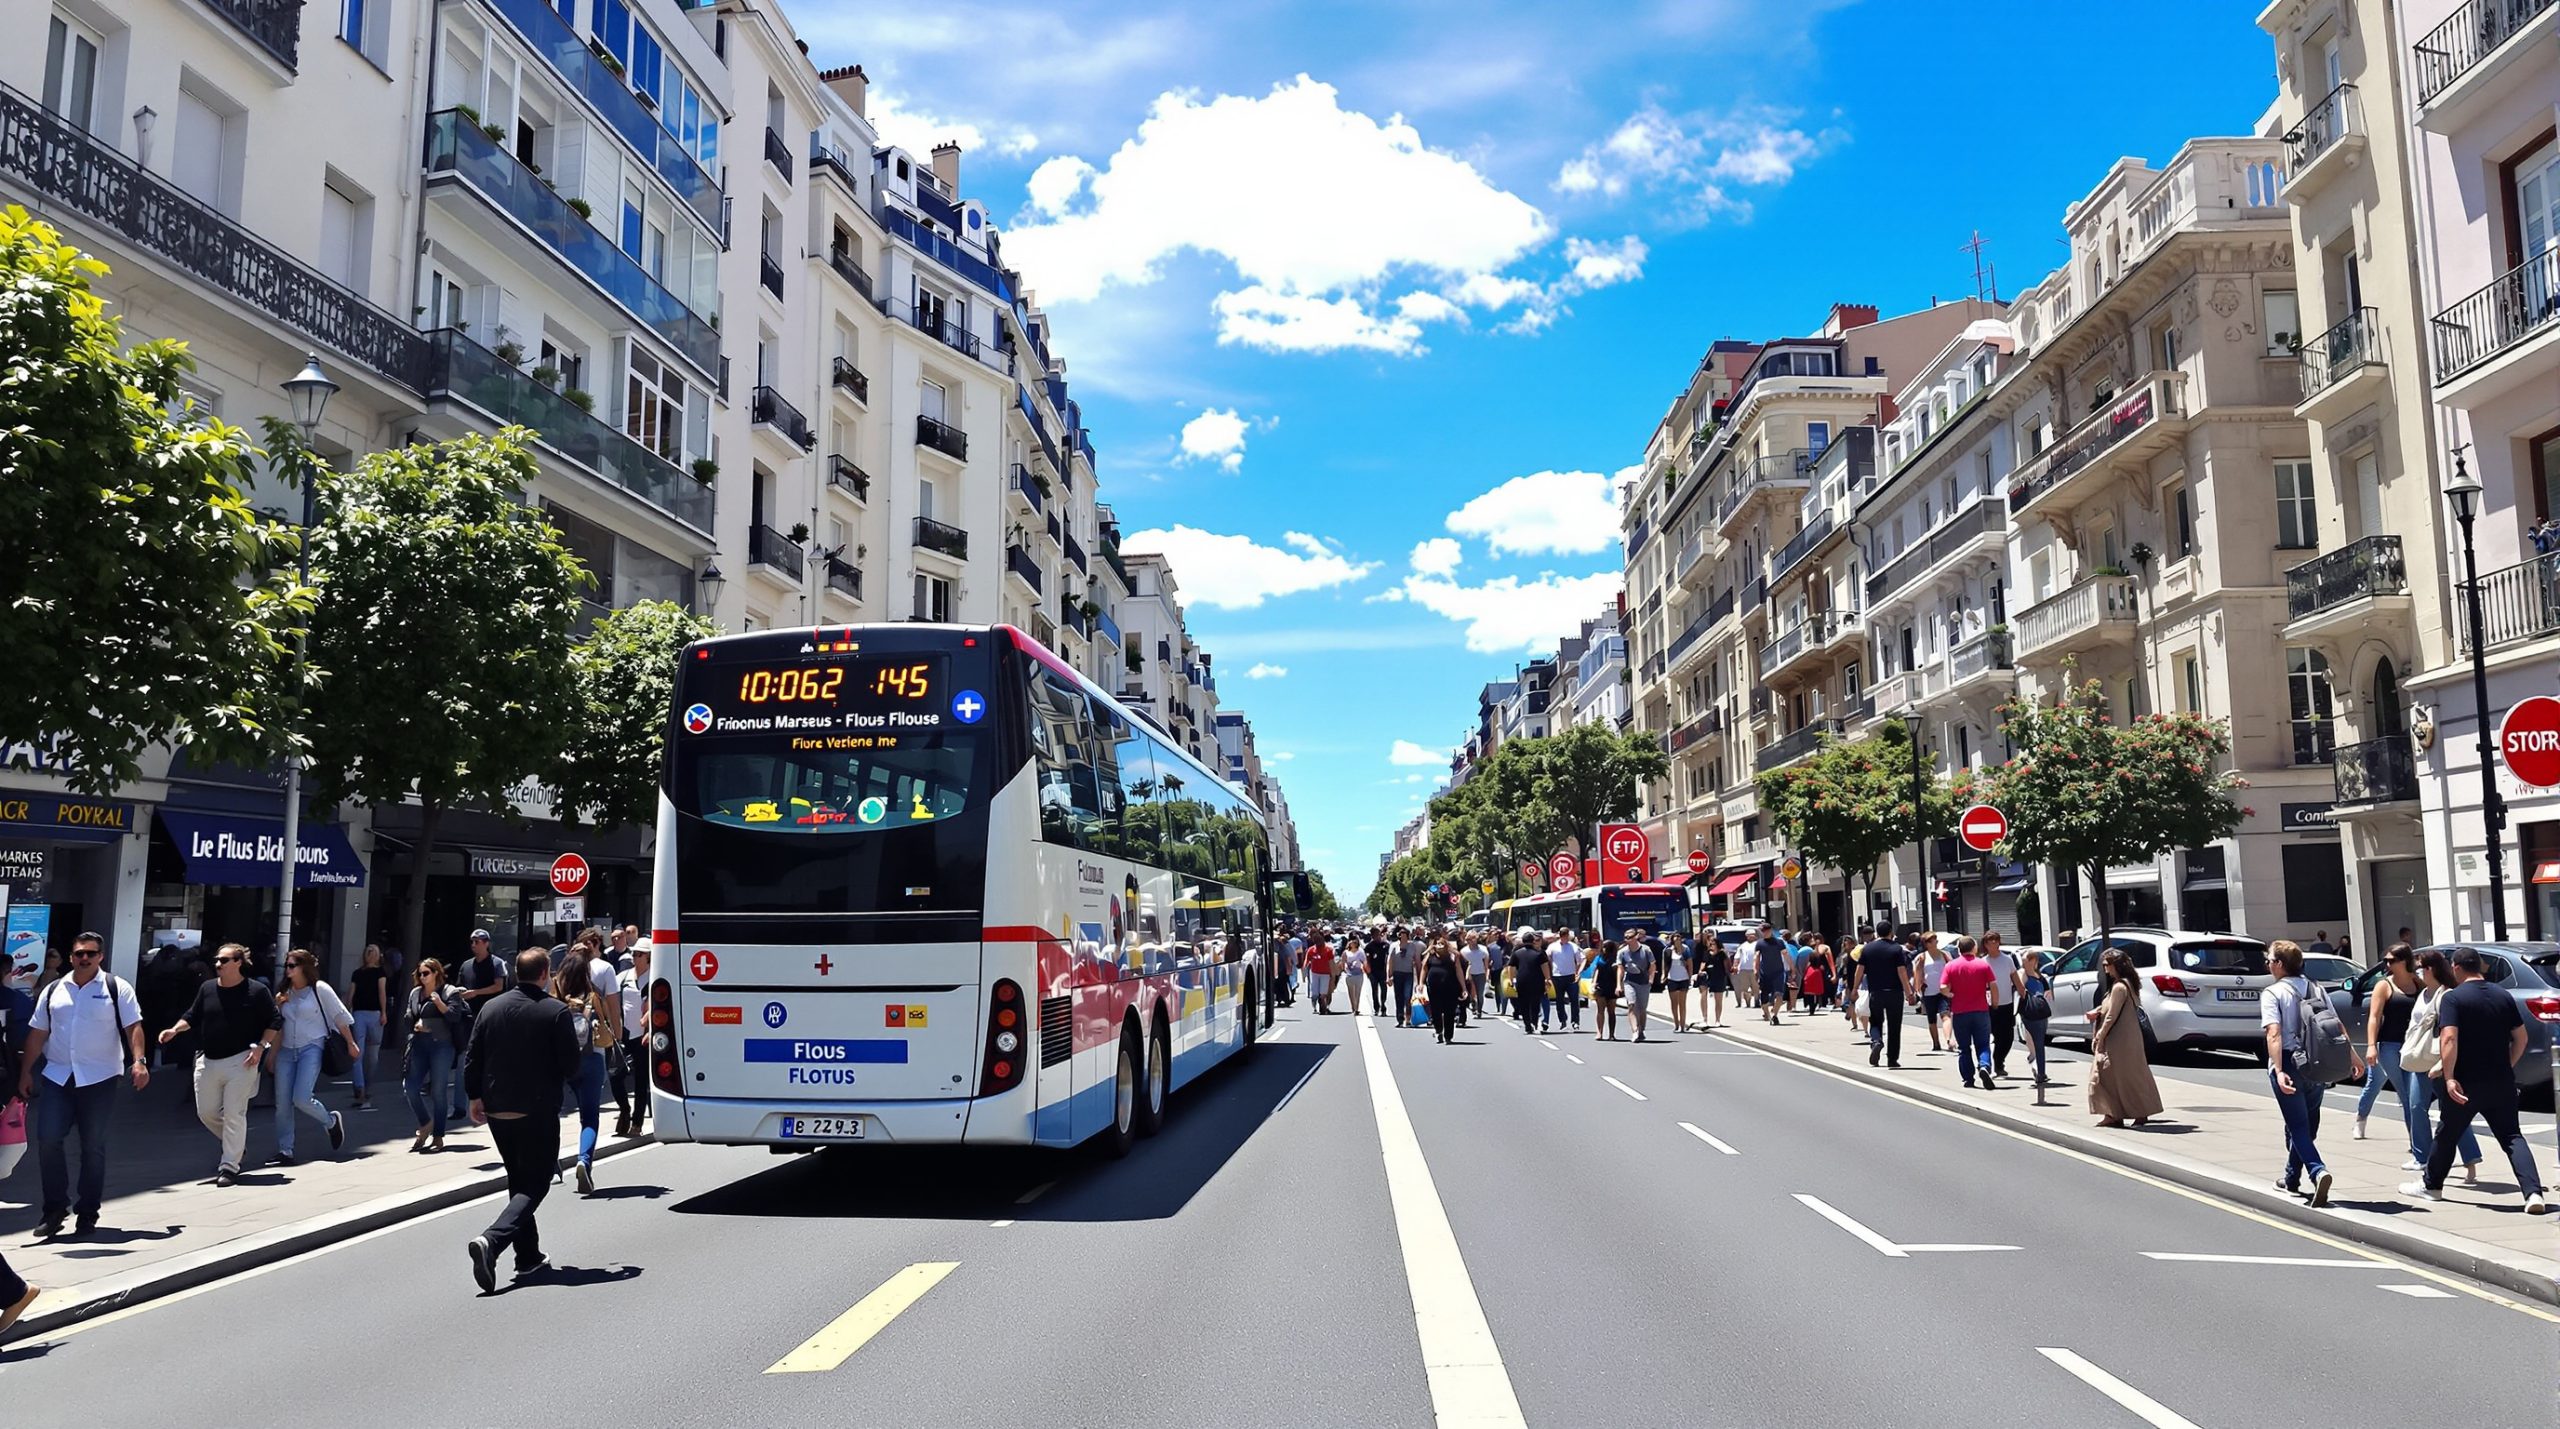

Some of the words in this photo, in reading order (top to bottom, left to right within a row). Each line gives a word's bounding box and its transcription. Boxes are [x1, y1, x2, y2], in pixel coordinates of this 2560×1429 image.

[553, 867, 585, 883] STOP
[794, 1042, 846, 1059] Flous
[789, 1068, 855, 1084] FLOTUS
